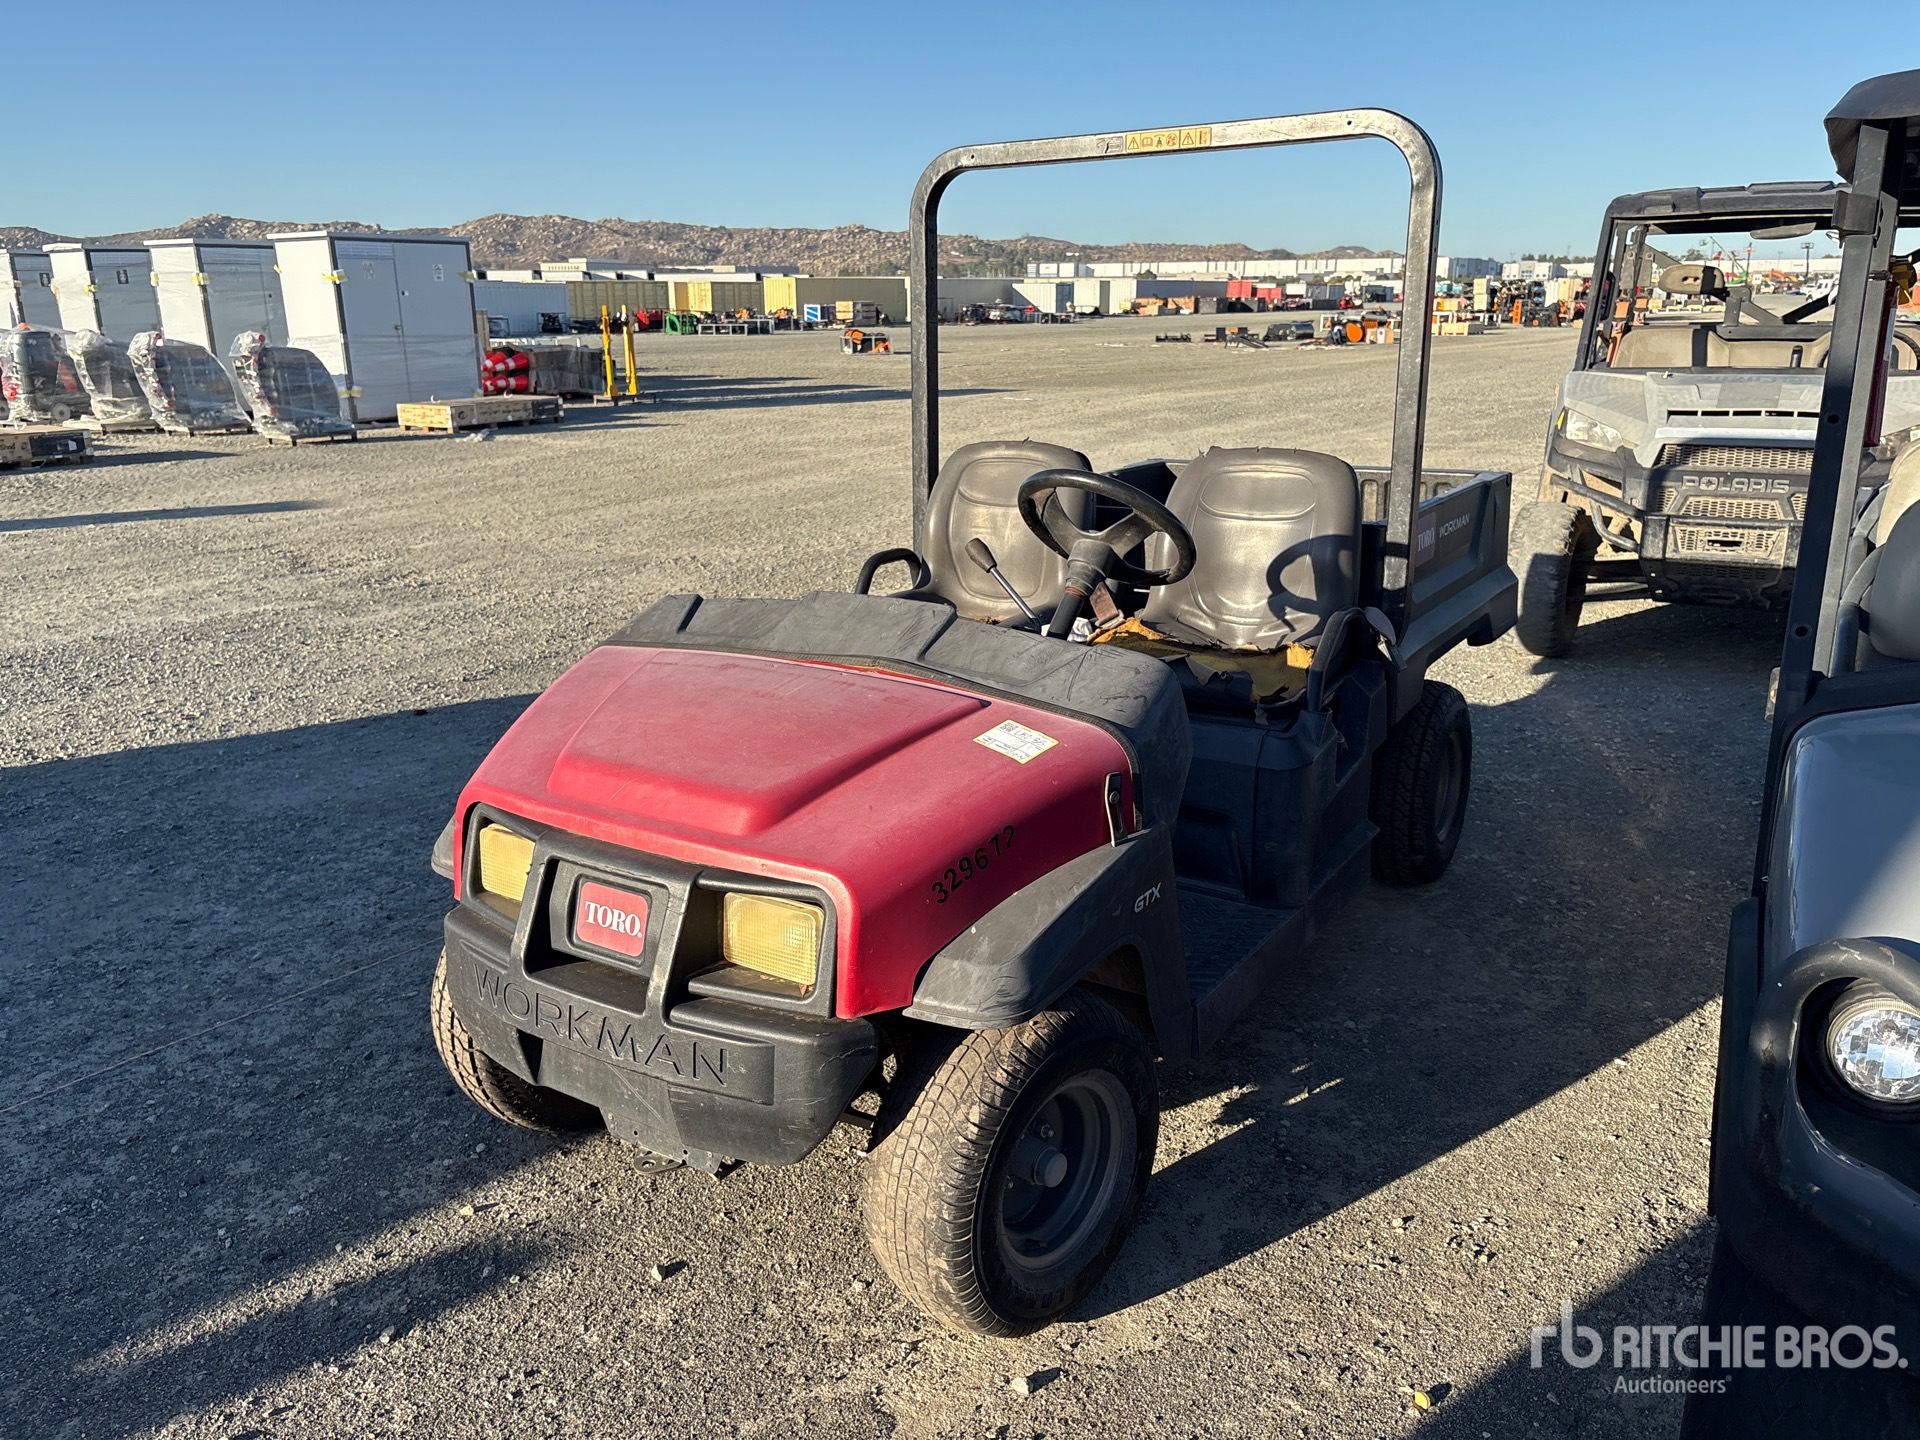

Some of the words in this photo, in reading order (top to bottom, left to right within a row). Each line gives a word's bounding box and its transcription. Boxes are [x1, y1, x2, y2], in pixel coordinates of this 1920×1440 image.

[1681, 475, 1790, 494] POLARIS
[1439, 512, 1471, 539] WORKMAN
[1417, 527, 1435, 552] TORO
[1134, 881, 1162, 913] GTX
[473, 963, 730, 1086] WORKMAN
